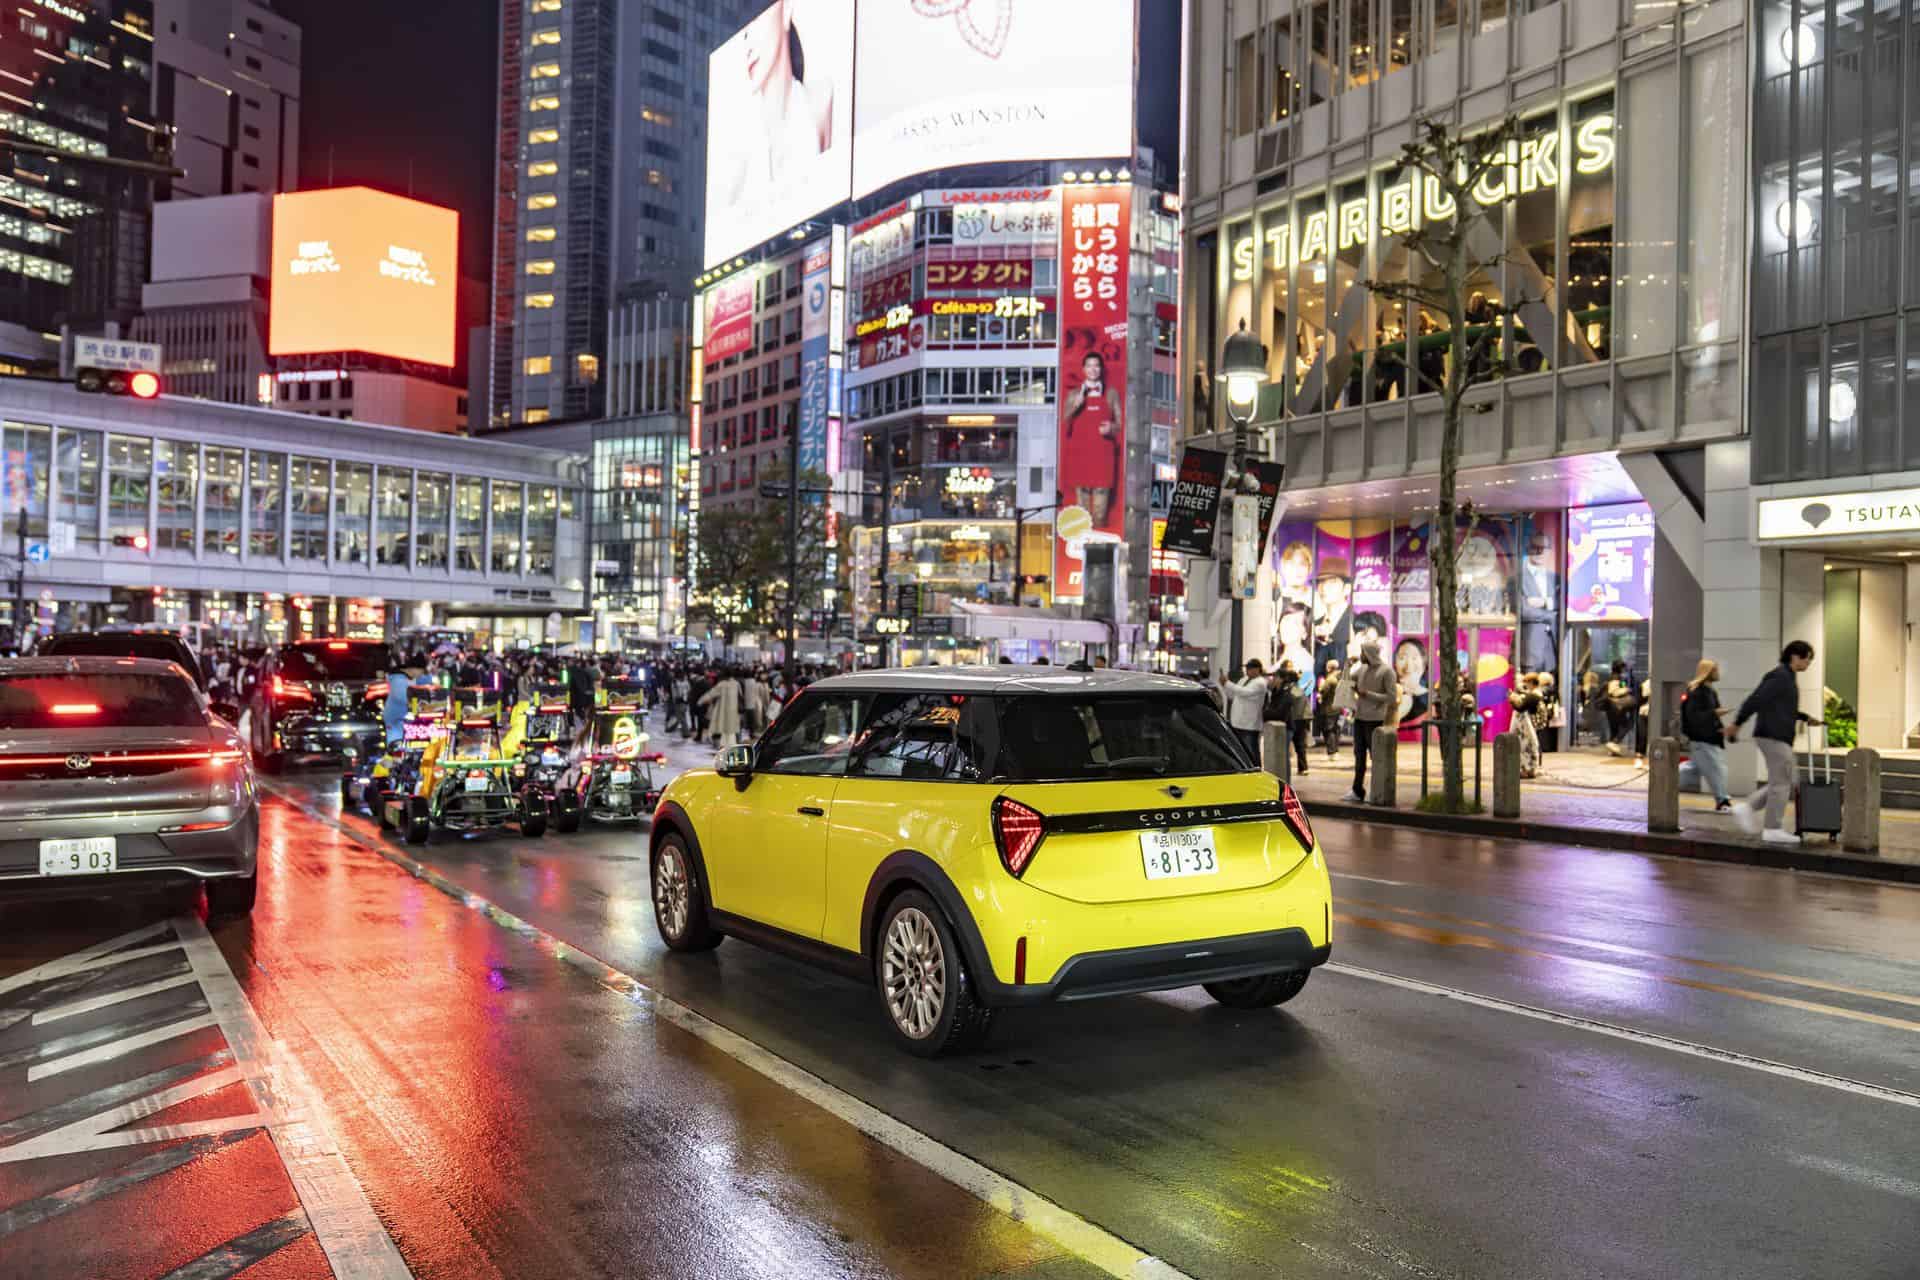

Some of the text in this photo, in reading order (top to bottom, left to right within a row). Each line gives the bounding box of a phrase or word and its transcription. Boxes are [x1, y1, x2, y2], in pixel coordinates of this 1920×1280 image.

[1233, 113, 1617, 281] STARBUCKS
[1071, 203, 1095, 312] 推しから。
[1096, 203, 1120, 311] 買うなら、
[927, 263, 1030, 284] コンタクト
[995, 296, 1046, 318] ガスト
[876, 333, 907, 362] ガスト
[1177, 480, 1217, 498] ON THE
[1173, 494, 1212, 512] STREET
[1355, 556, 1384, 567] NHK
[1139, 808, 1222, 822] COOPER
[1161, 848, 1214, 874] 81-33
